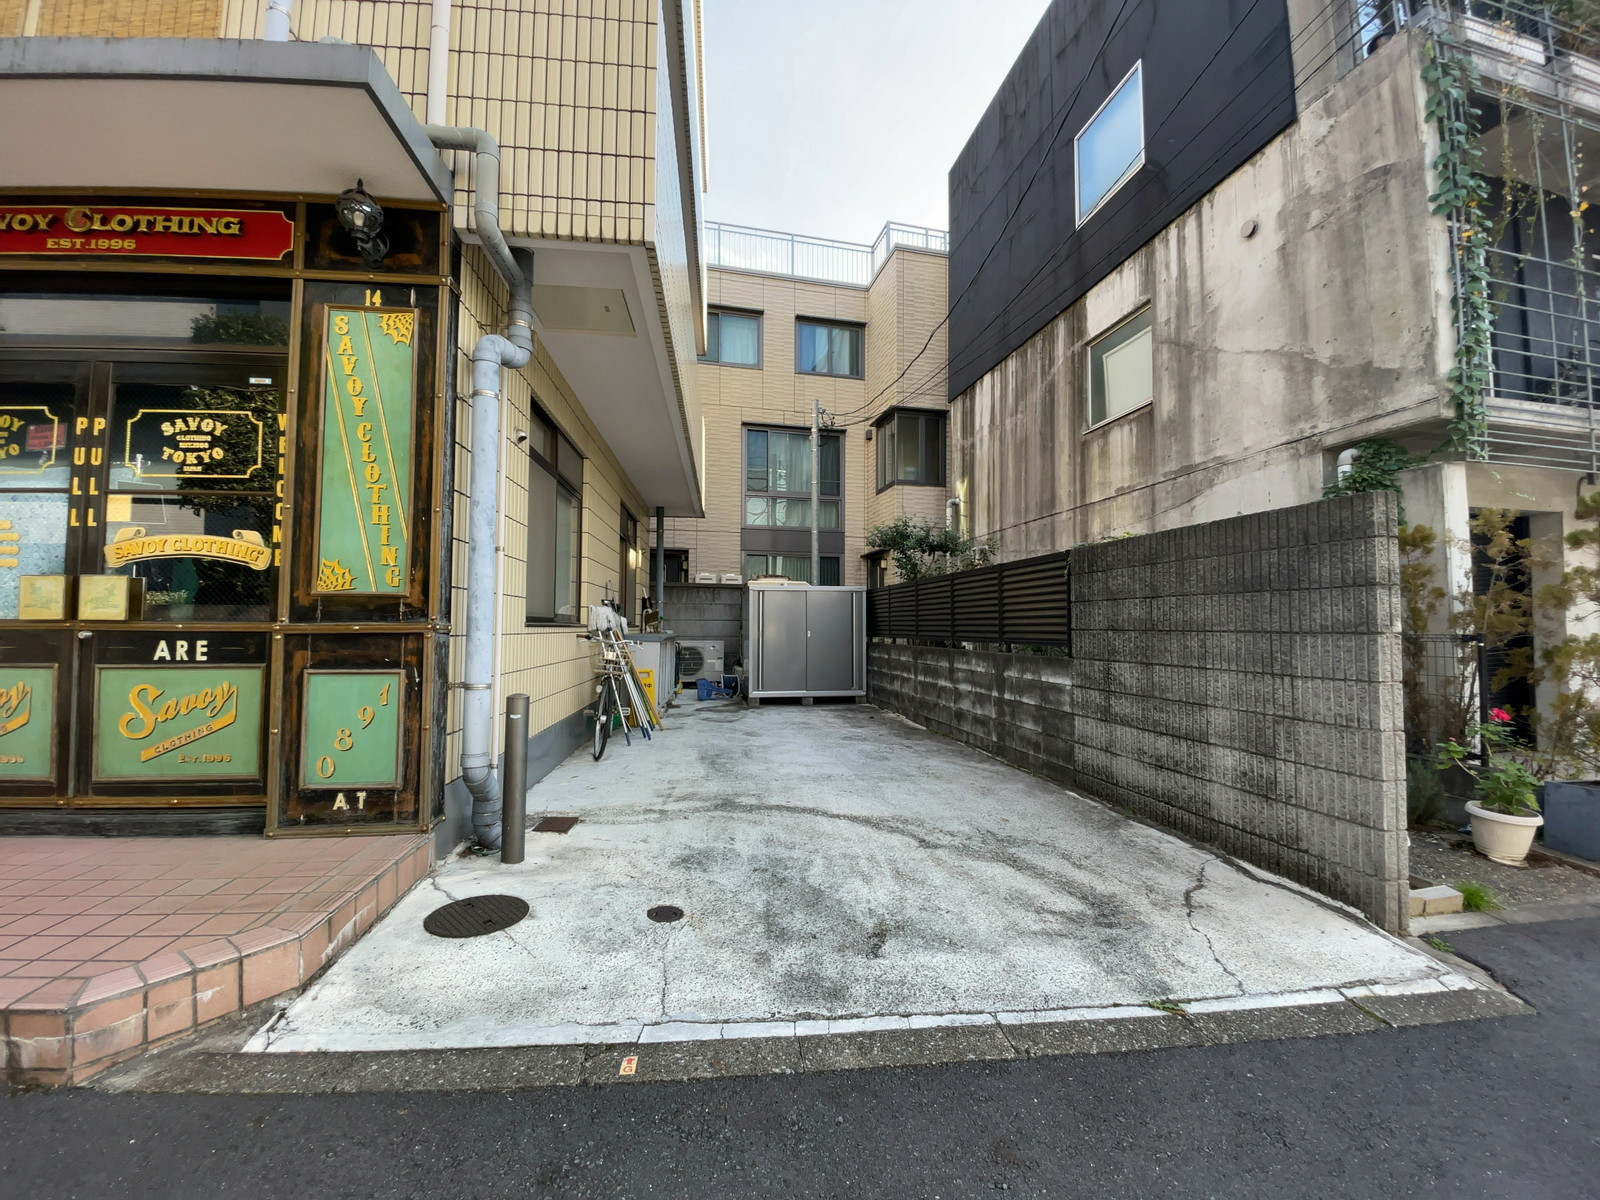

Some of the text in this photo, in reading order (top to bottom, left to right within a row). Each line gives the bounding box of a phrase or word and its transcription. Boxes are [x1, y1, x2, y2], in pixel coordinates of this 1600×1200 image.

[64, 207, 241, 234] CLOTHING
[47, 238, 136, 250] EST.1996
[161, 417, 228, 436] SAVOY
[161, 446, 224, 464] TOKYO
[334, 315, 402, 588] SAVOY CLOTHING
[114, 537, 264, 563] SAVOY CLOTHING
[153, 640, 208, 661] ARE
[118, 680, 237, 739] Savoy
[154, 724, 214, 755] CLOTHING
[333, 792, 367, 810] AT
[623, 1065, 633, 1073] G
